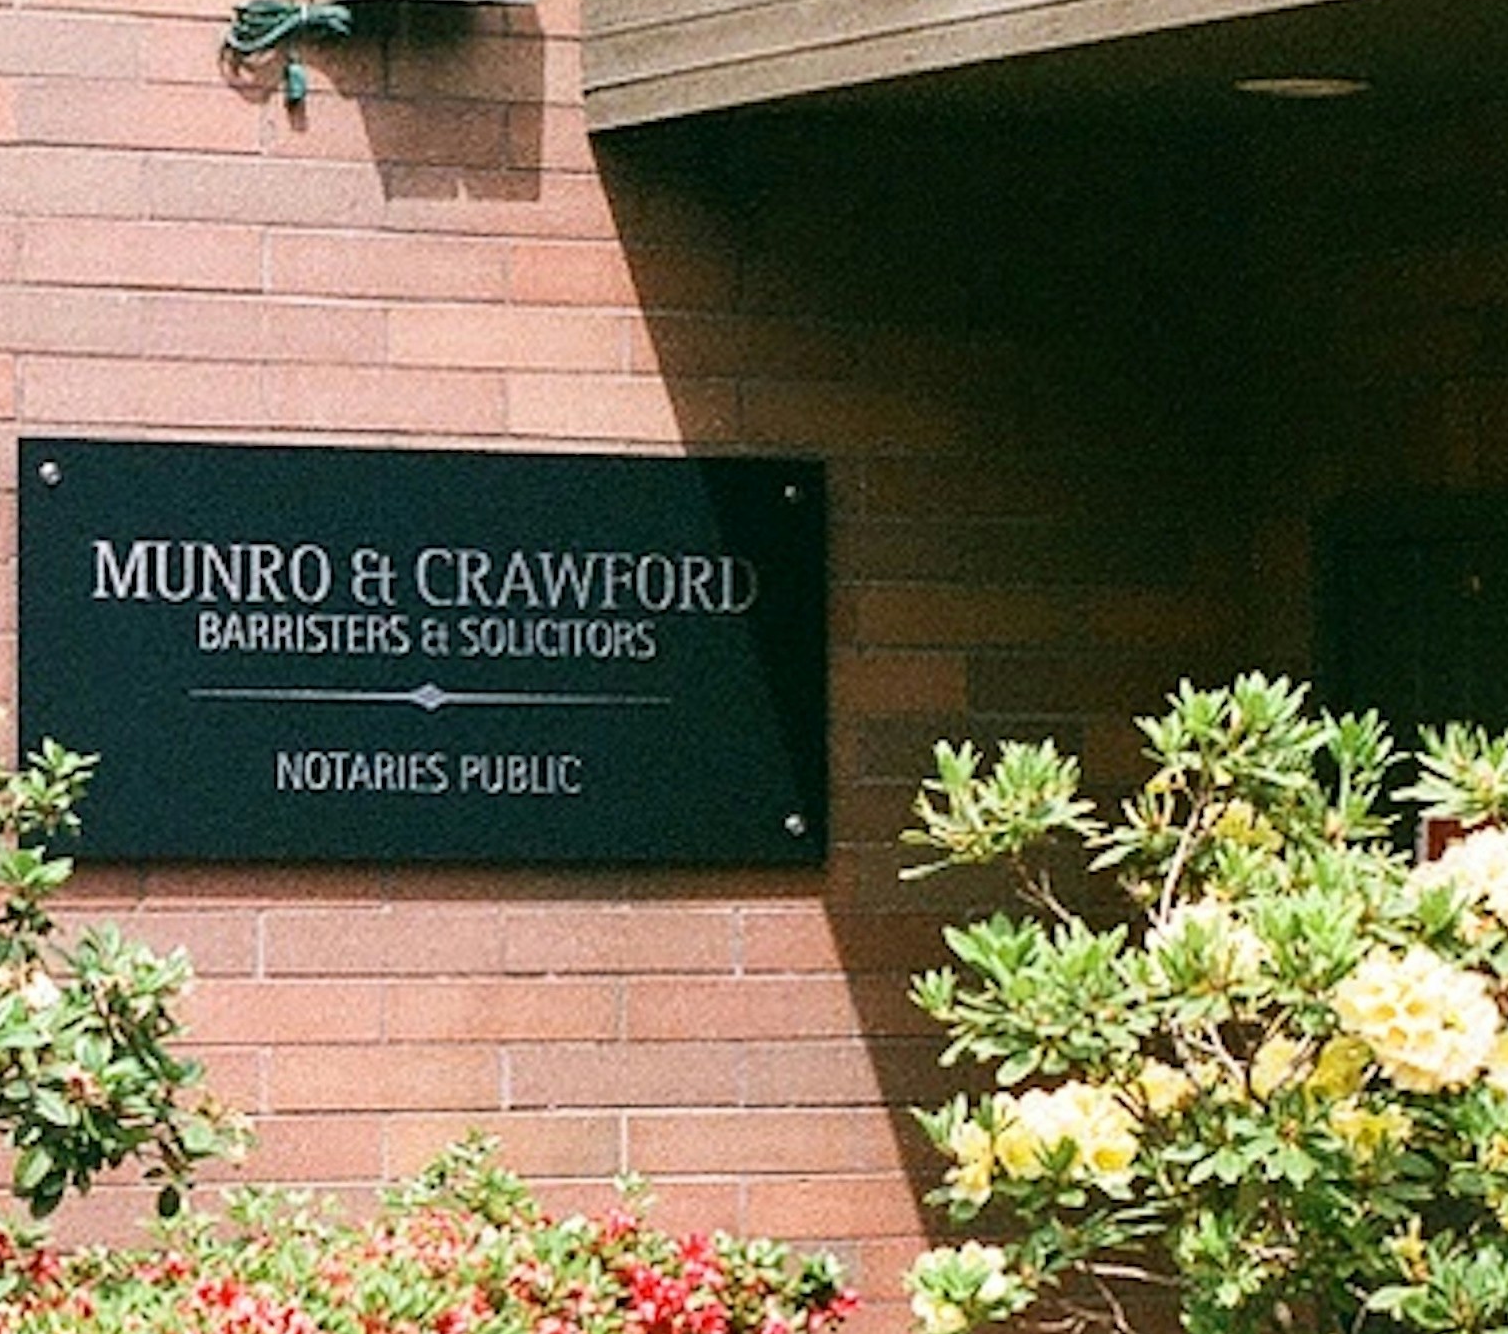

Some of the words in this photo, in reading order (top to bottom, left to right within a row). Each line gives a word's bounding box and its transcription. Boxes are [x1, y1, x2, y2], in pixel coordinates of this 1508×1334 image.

[92, 540, 332, 604] MUNRO
[351, 547, 397, 605] &
[415, 547, 759, 615] CRAWFORD
[197, 612, 411, 656] BARRISTERS
[421, 619, 452, 656] &
[457, 619, 658, 660] SOLICITORS
[275, 750, 450, 794] NOTARIES
[460, 754, 583, 795] PUBLIC
